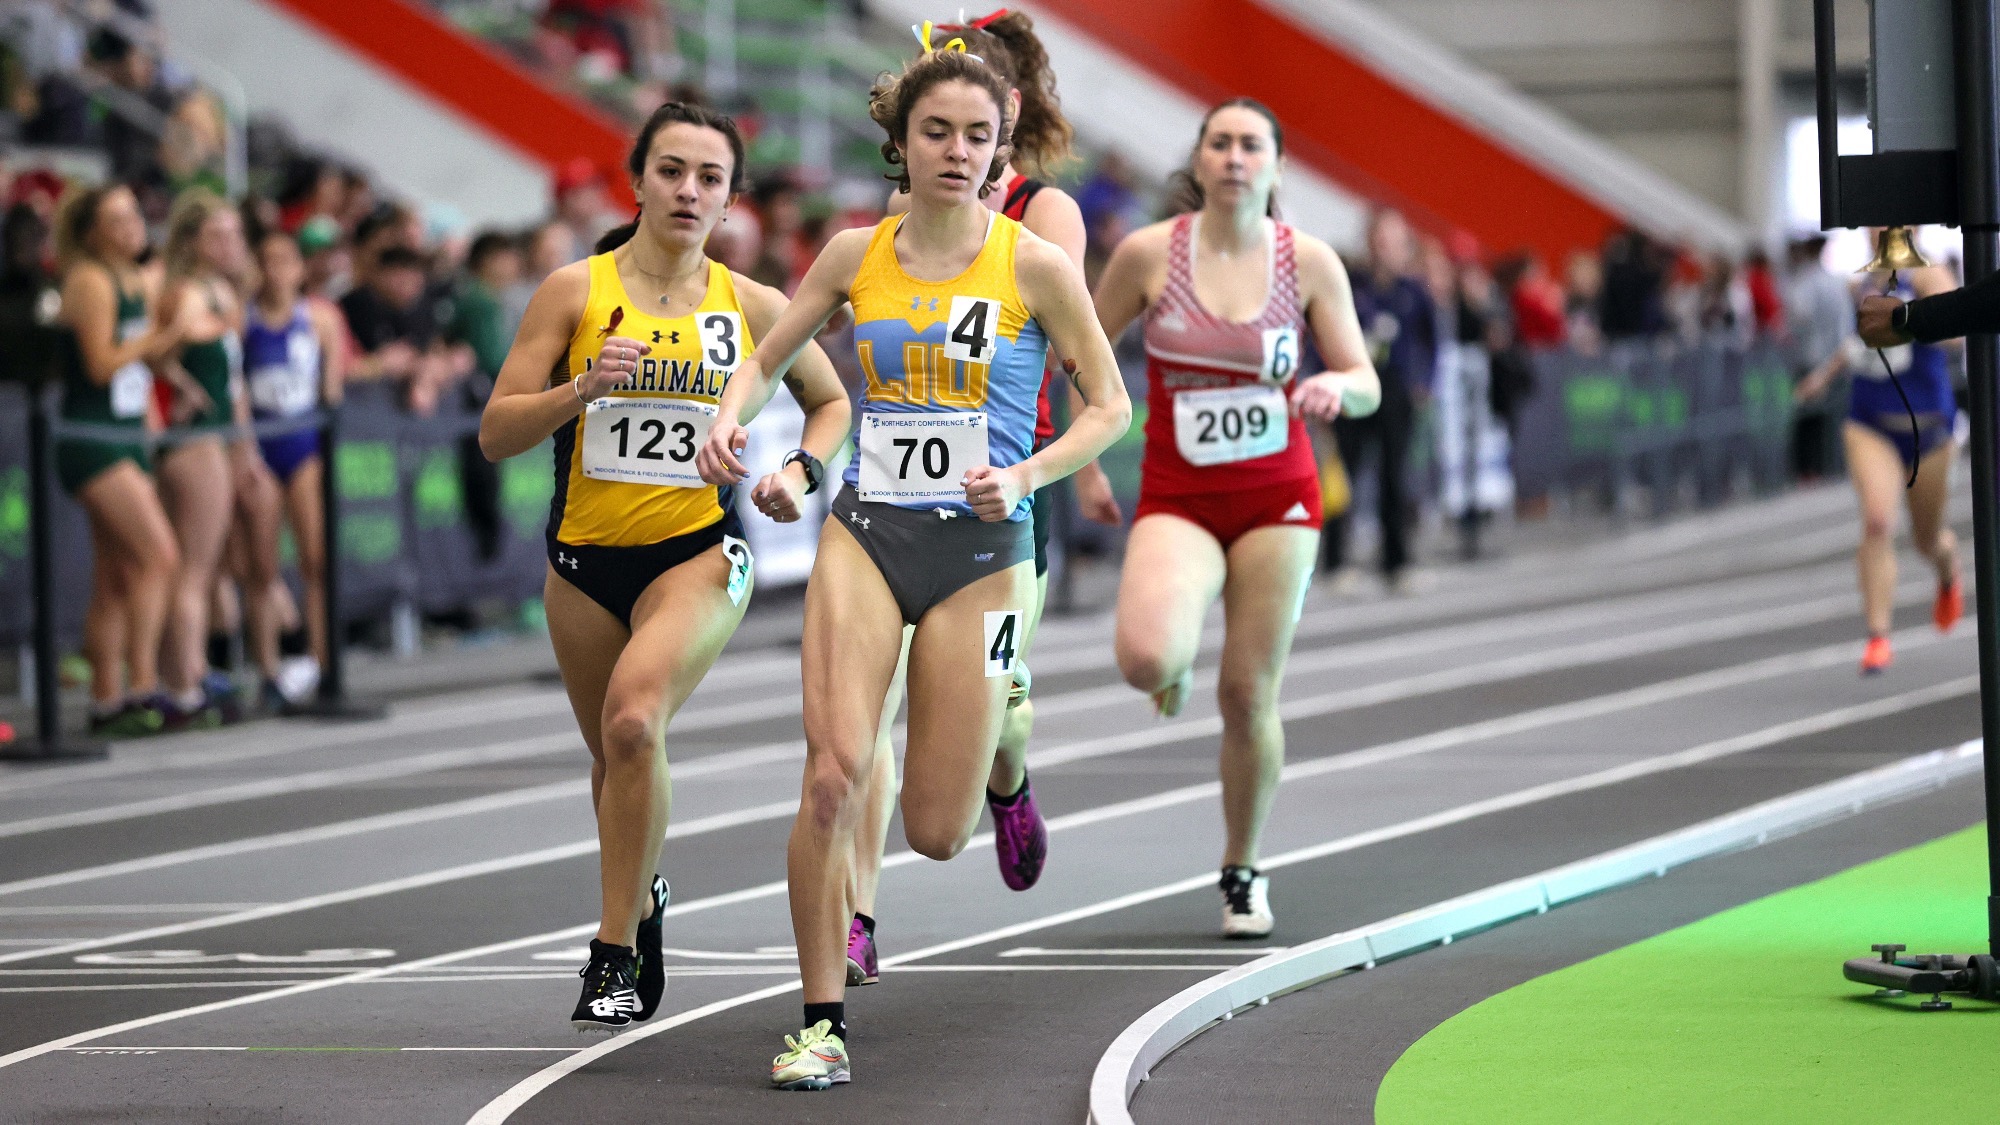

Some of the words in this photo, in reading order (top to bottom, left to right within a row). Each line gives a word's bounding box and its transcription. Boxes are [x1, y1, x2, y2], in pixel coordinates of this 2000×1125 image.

[704, 314, 736, 367] 3
[952, 301, 989, 358] 4
[857, 340, 990, 409] LIU
[1271, 335, 1291, 380] 6
[653, 403, 700, 413] CONFERENCE
[1196, 405, 1268, 444] 209
[610, 417, 696, 463] 123
[893, 437, 950, 480] 70
[617, 468, 636, 476] TRACK
[990, 614, 1015, 670] 4
